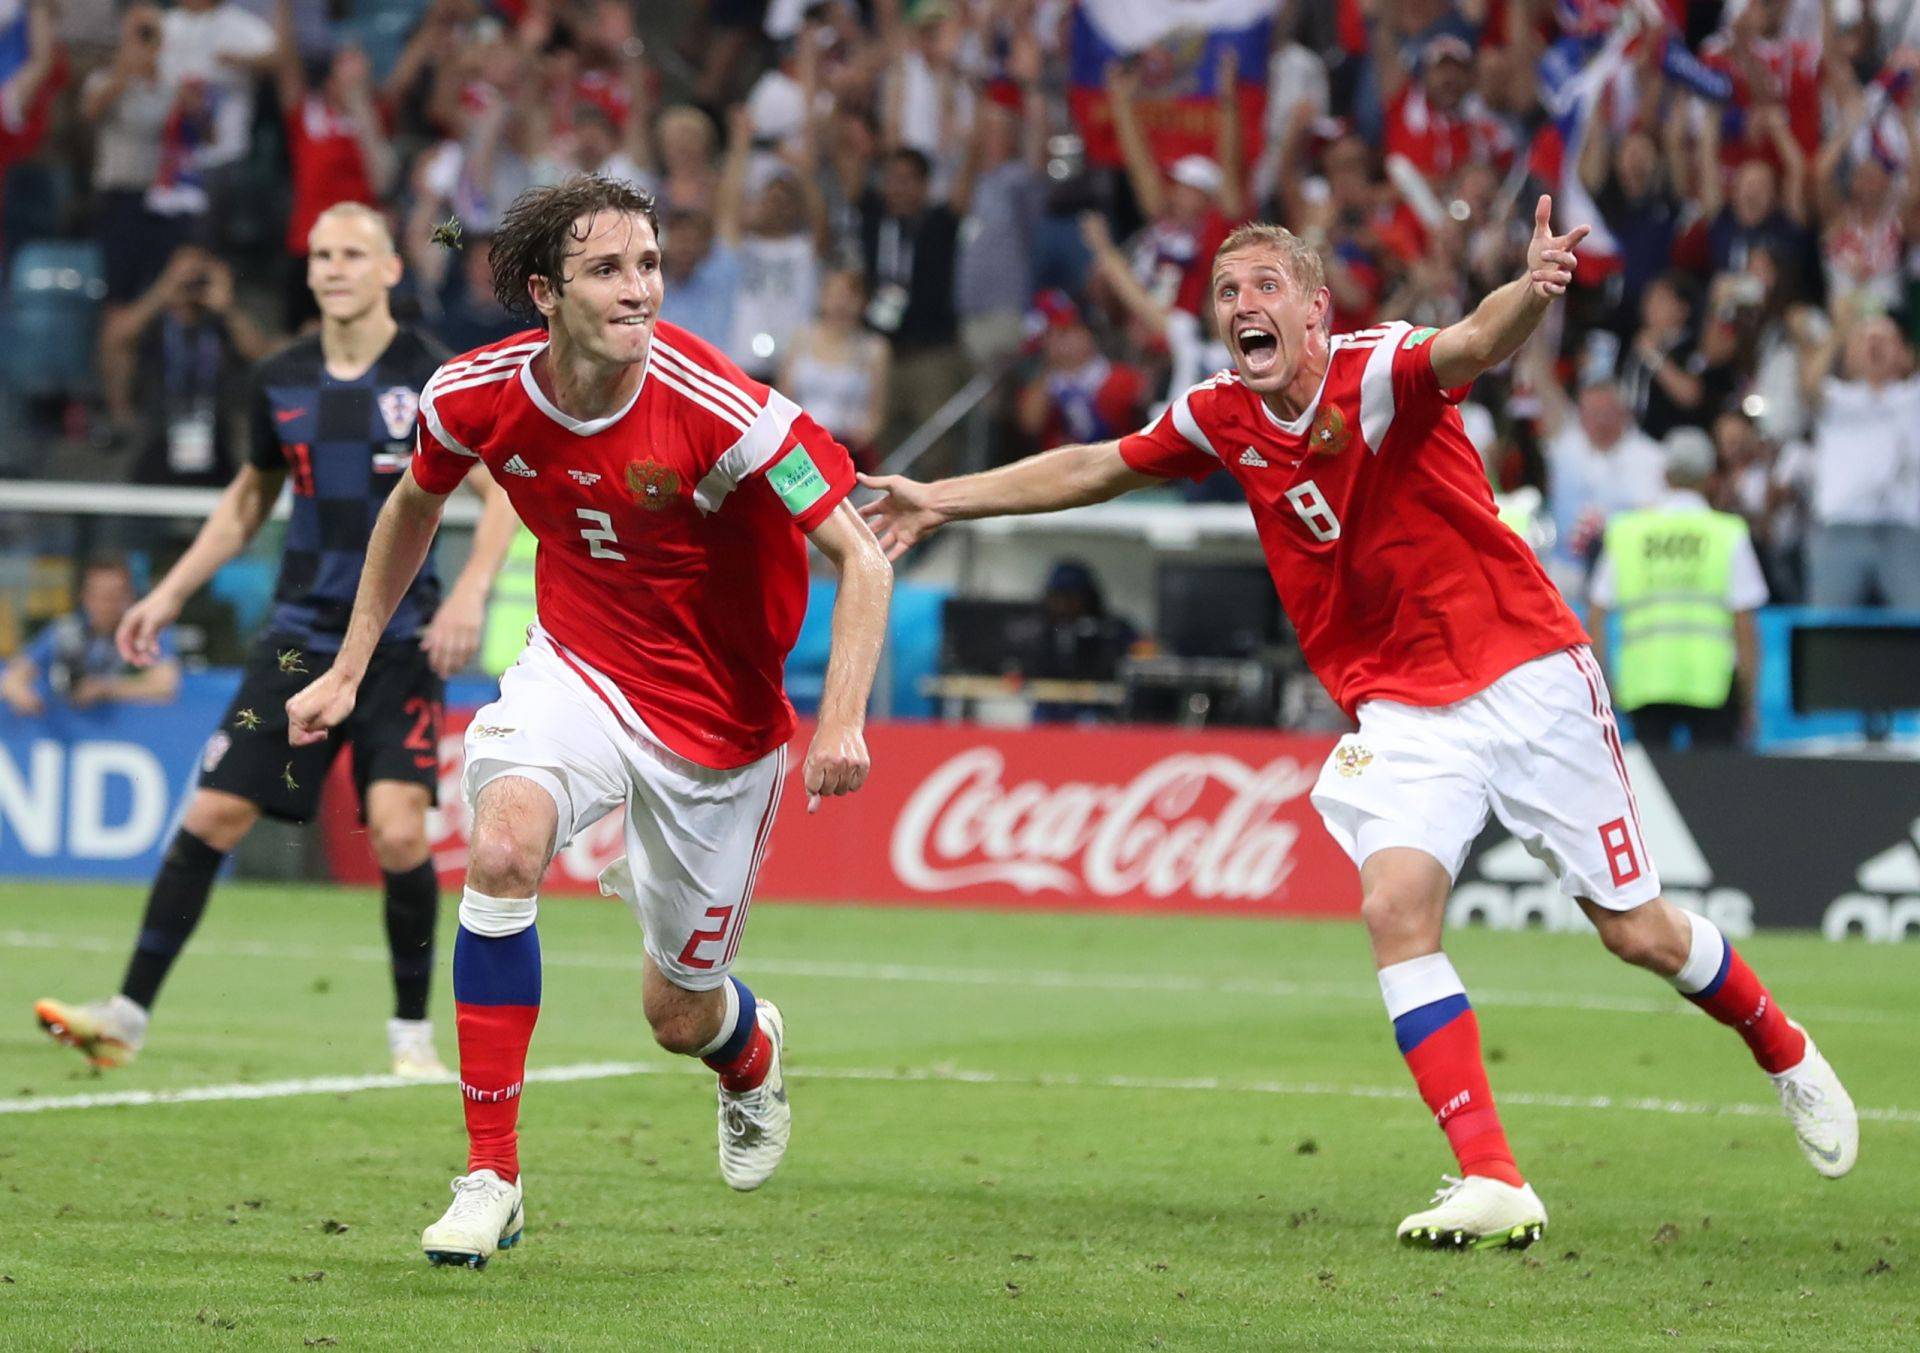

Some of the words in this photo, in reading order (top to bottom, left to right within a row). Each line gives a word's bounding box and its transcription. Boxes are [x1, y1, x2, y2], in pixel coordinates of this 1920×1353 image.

[576, 508, 627, 561] 2
[1284, 480, 1341, 542] 8
[0, 738, 175, 861] ND
[890, 746, 1314, 898] Coca-Cola
[1598, 816, 1641, 889] 8
[677, 905, 734, 969] 2
